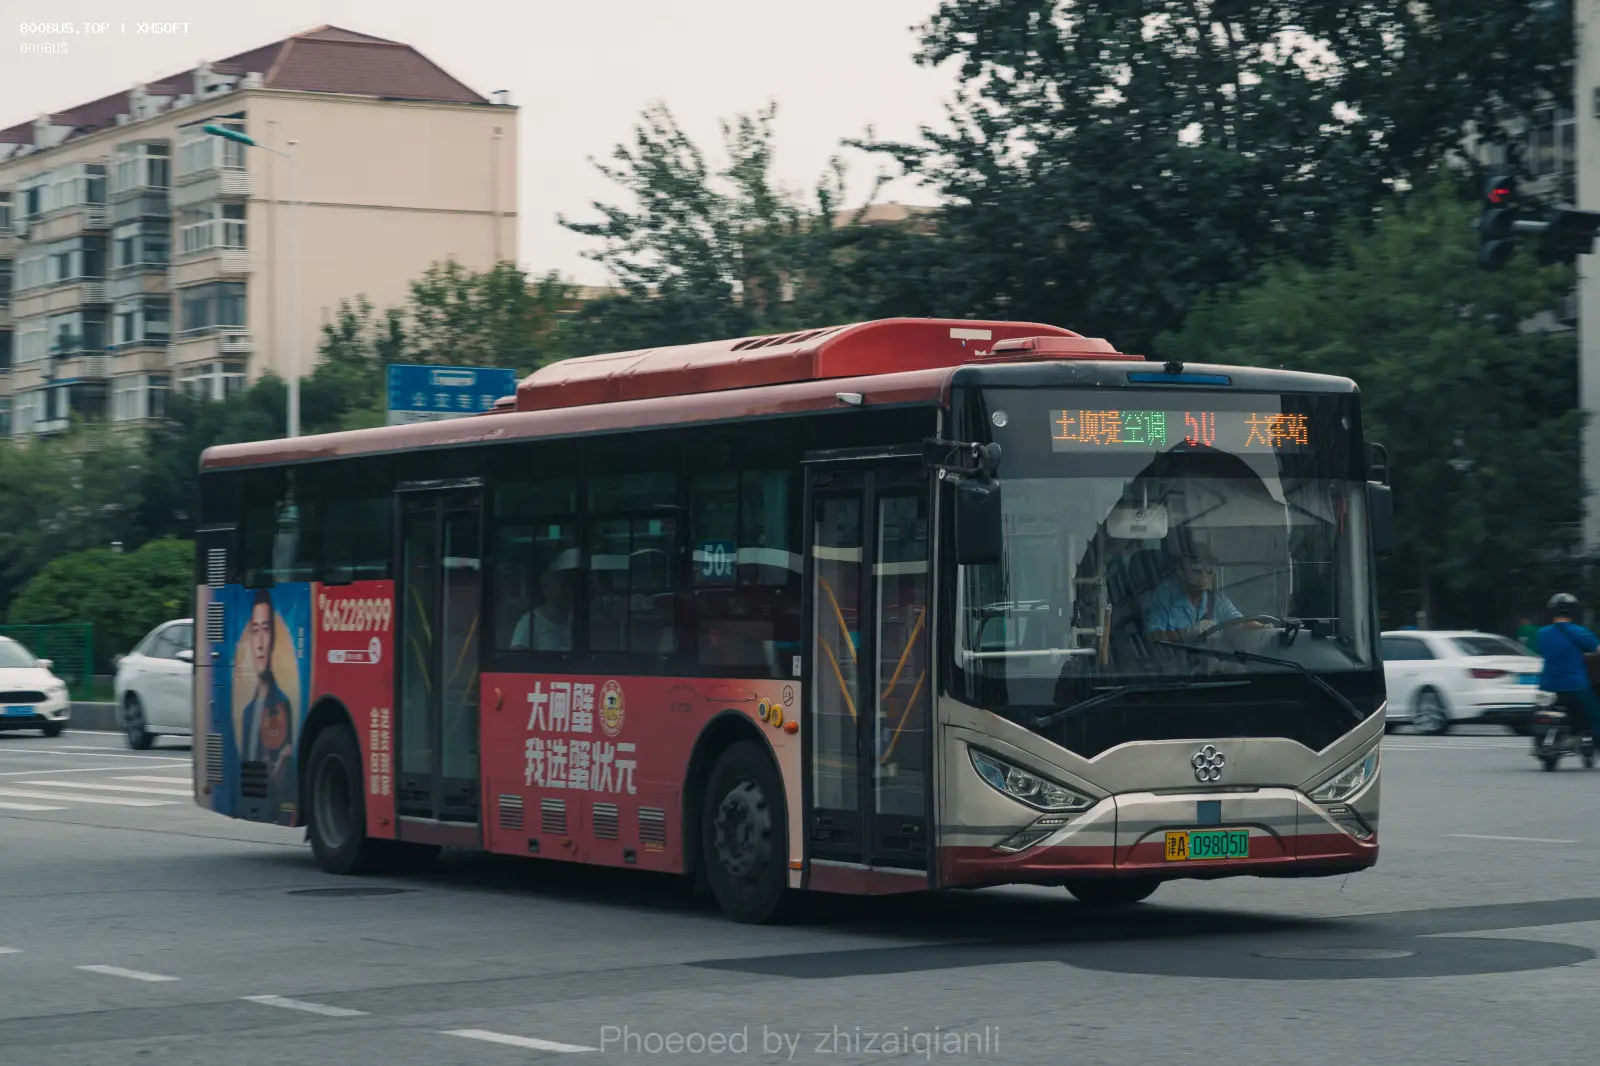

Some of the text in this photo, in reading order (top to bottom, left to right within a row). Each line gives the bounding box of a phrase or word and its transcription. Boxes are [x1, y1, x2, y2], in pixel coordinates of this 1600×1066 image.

[323, 598, 391, 632] 66228999
[526, 681, 595, 734] 大闸蟹
[524, 738, 638, 795] 我选蟹状元
